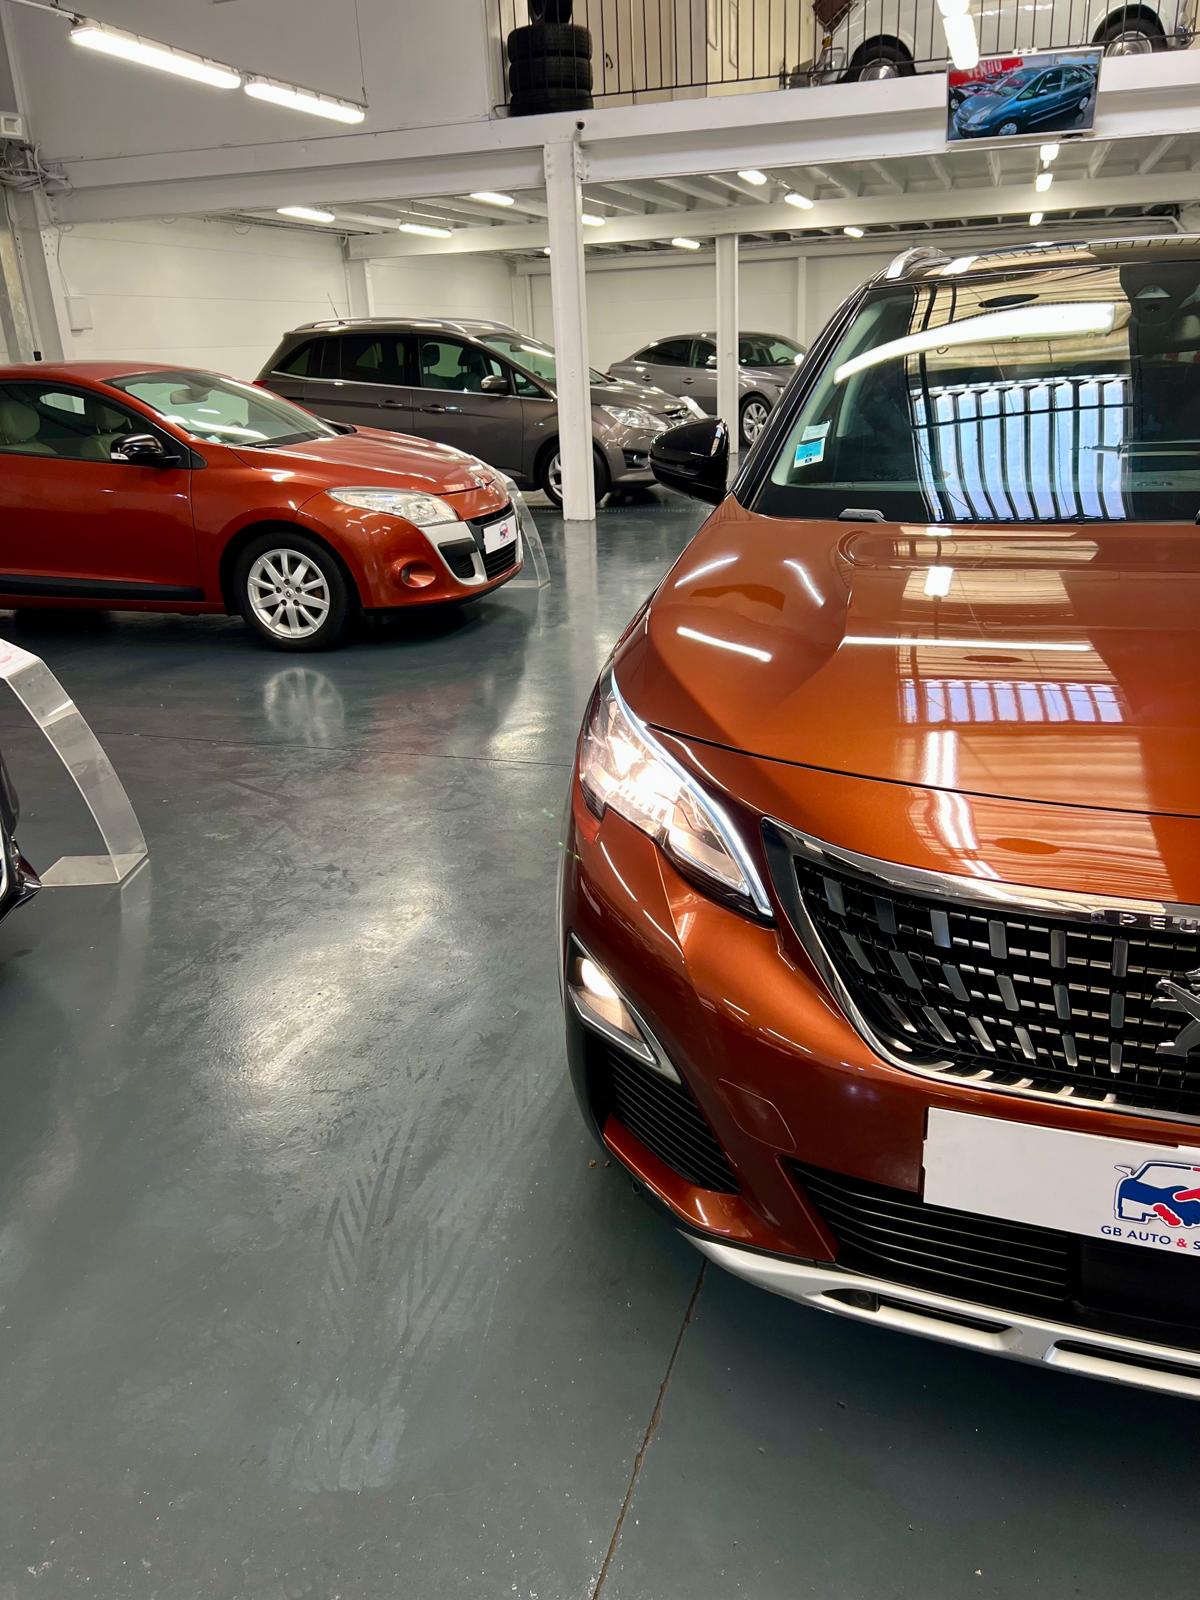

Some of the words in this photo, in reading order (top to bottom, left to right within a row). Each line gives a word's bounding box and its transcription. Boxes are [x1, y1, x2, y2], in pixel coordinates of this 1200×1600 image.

[967, 60, 1003, 79] VENDU
[1100, 1225, 1122, 1237] GB
[1127, 1230, 1172, 1245] AUTO
[1176, 1238, 1188, 1249] &
